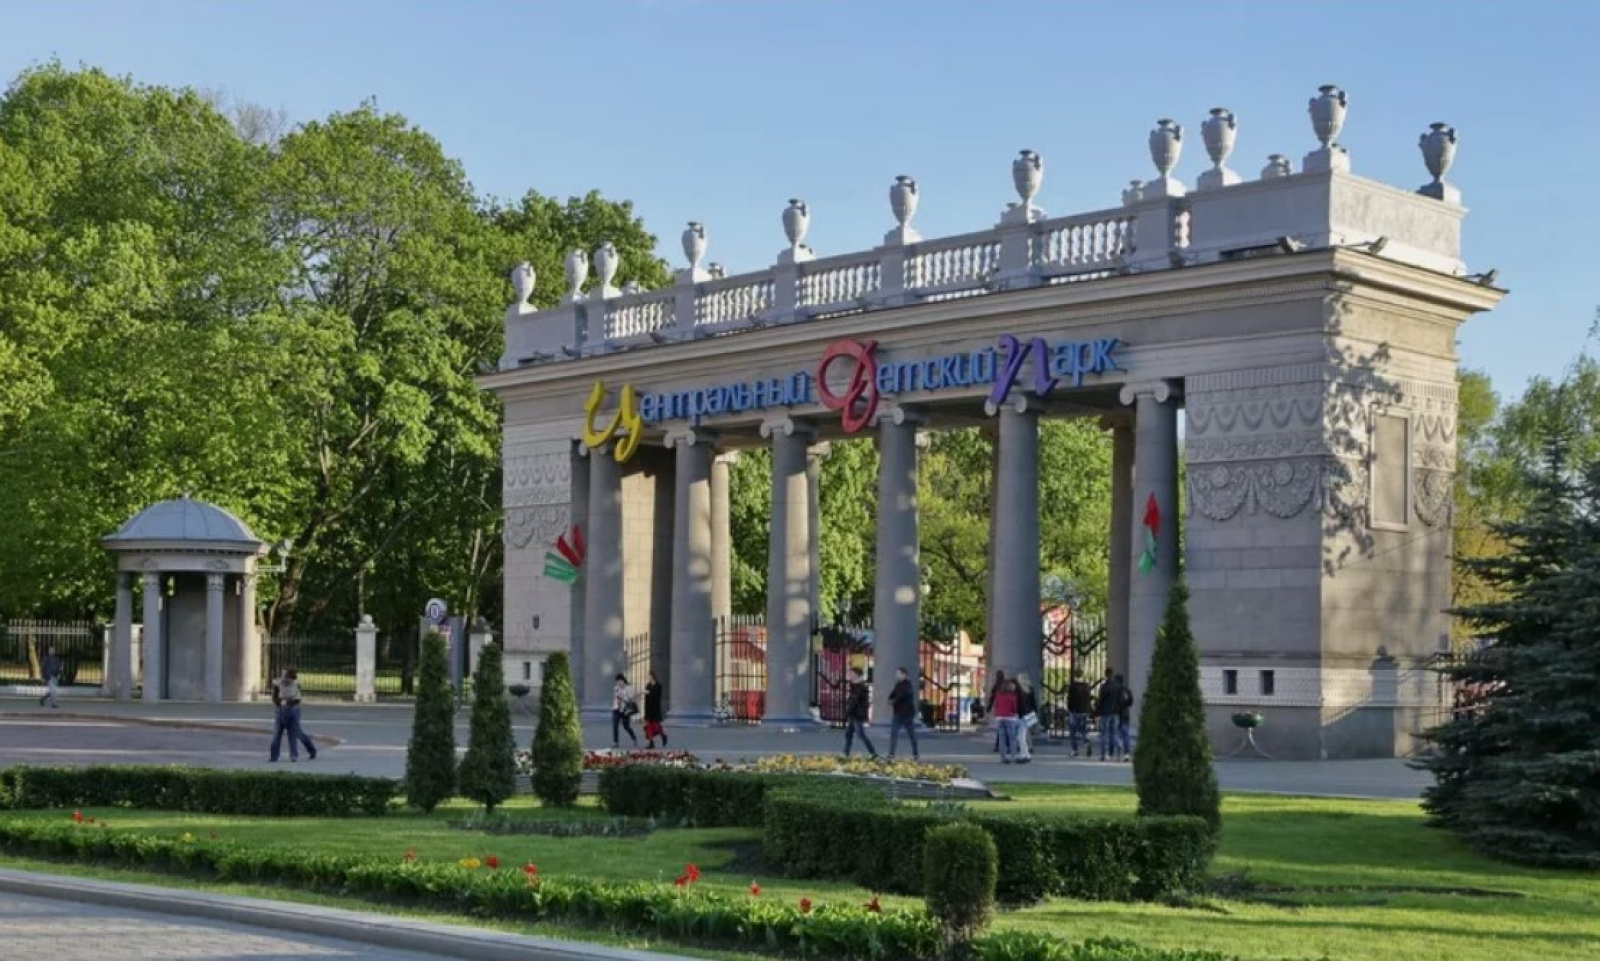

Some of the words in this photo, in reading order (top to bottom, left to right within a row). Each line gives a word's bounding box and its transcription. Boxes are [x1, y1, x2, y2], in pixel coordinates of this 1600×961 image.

[584, 371, 811, 462] Центральный
[818, 339, 997, 432] Детский
[988, 335, 1121, 405] Парк
